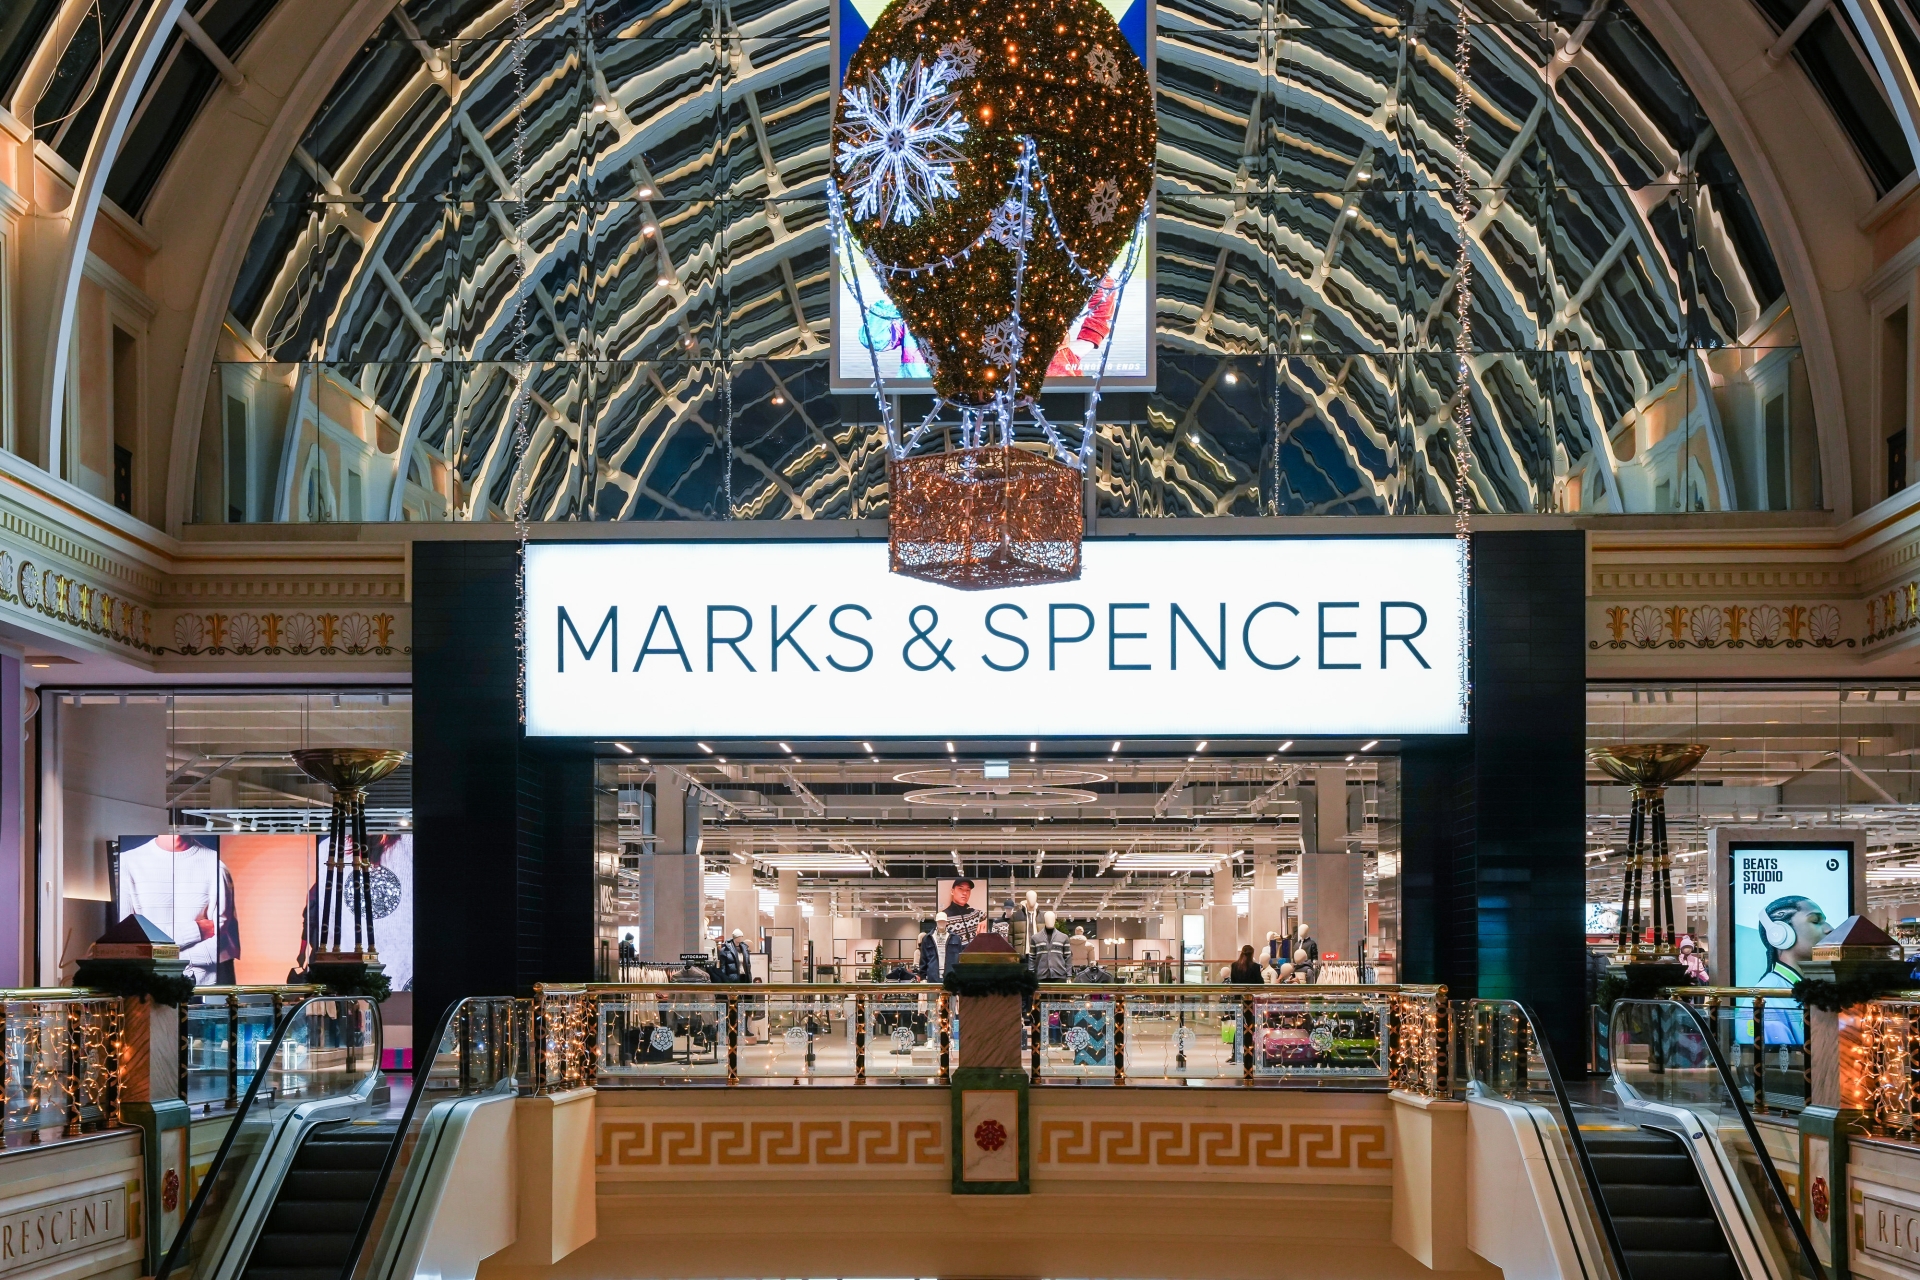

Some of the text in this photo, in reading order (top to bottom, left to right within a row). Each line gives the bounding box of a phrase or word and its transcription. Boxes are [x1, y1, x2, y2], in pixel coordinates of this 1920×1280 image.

[1065, 363, 1140, 371] CHANGIG ENDS
[557, 601, 1432, 673] MARKS & SPENCER
[1743, 858, 1778, 870] BEATS
[1743, 870, 1783, 882] STUDIO
[1743, 882, 1766, 894] PRO
[3, 1199, 113, 1260] RESCENT
